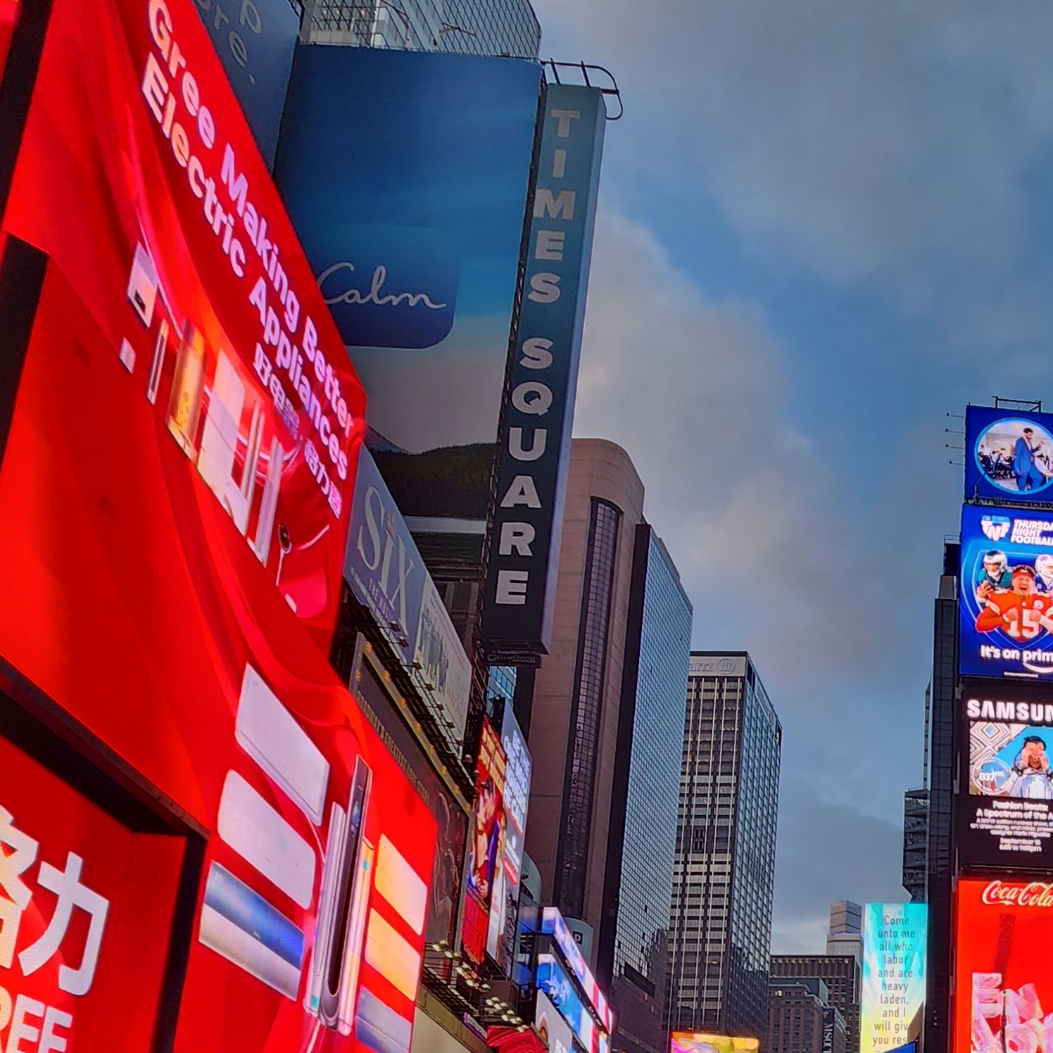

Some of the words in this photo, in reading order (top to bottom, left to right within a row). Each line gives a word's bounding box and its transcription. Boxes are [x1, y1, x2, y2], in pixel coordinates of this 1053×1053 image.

[528, 108, 582, 303] TIMES
[149, 1, 215, 149] Gree
[221, 143, 300, 333] Making
[303, 315, 354, 438] Better
[142, 52, 246, 277] Electric
[250, 277, 347, 480] Appliances
[317, 262, 447, 309] Calm
[495, 337, 554, 604] SQUARE
[1013, 529, 1041, 538] NIGHT
[981, 645, 1001, 658] It's
[1003, 649, 1020, 659] on
[884, 914, 910, 926] Come
[878, 929, 898, 939] unto
[901, 930, 915, 939] me
[879, 943, 891, 952] all
[894, 943, 913, 952] who
[883, 955, 908, 964] labor
[877, 969, 895, 978] and
[898, 969, 913, 978] are
[881, 982, 909, 993] heavy
[880, 994, 909, 1005] laden,
[882, 1008, 899, 1018] and
[874, 1022, 891, 1031] will
[872, 1036, 889, 1048] you
